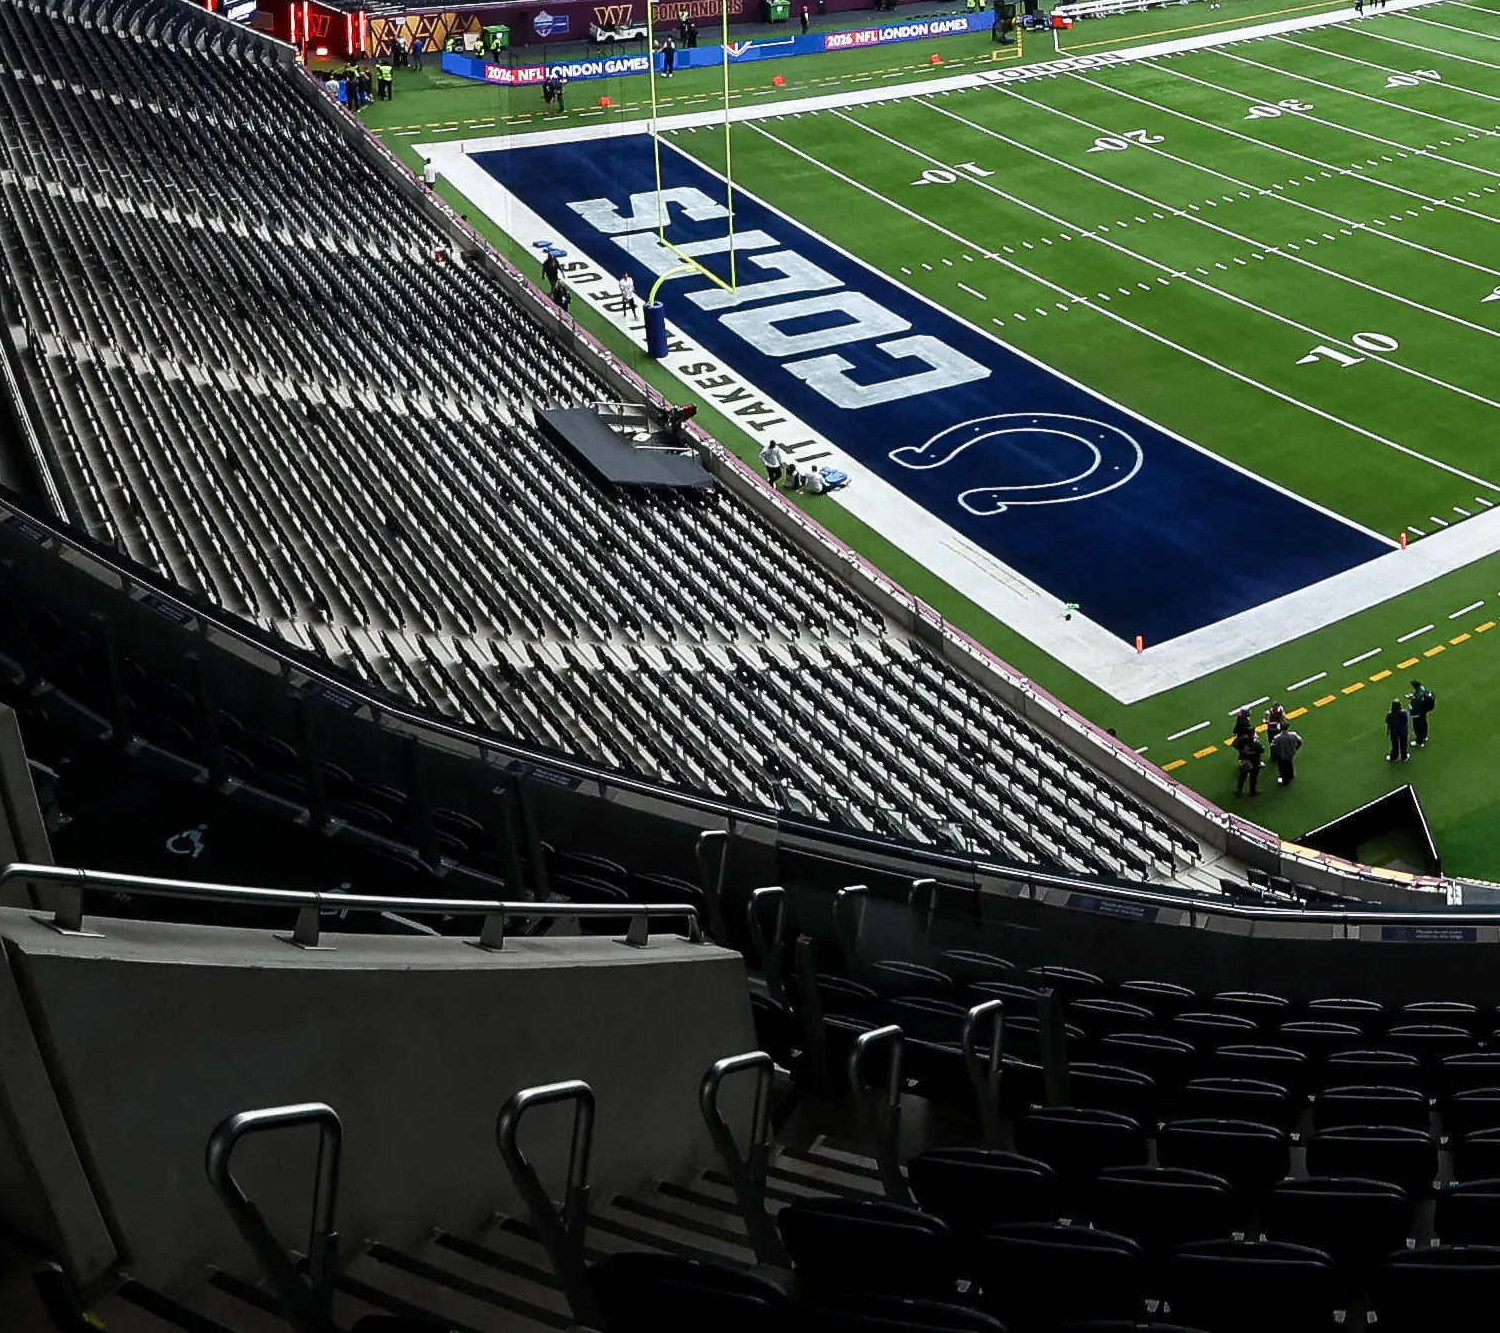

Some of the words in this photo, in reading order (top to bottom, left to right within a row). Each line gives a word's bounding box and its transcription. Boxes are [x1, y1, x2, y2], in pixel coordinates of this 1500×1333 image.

[827, 35, 853, 47] 2026
[855, 31, 878, 44] NFL
[879, 25, 928, 41] LONDON
[930, 18, 969, 34] GAMES
[487, 65, 514, 81] 2026
[517, 67, 545, 81] NFL
[545, 62, 602, 78] LONDON
[604, 57, 649, 72] GAMES
[975, 51, 1126, 83] LONDON
[1386, 68, 1442, 88] 40
[1249, 98, 1314, 119] 30
[1093, 127, 1166, 152] 20
[925, 161, 996, 184] 10
[560, 261, 603, 285] US
[565, 186, 993, 410] COLTS
[1314, 331, 1399, 369] 10
[678, 361, 788, 433] TAKES
